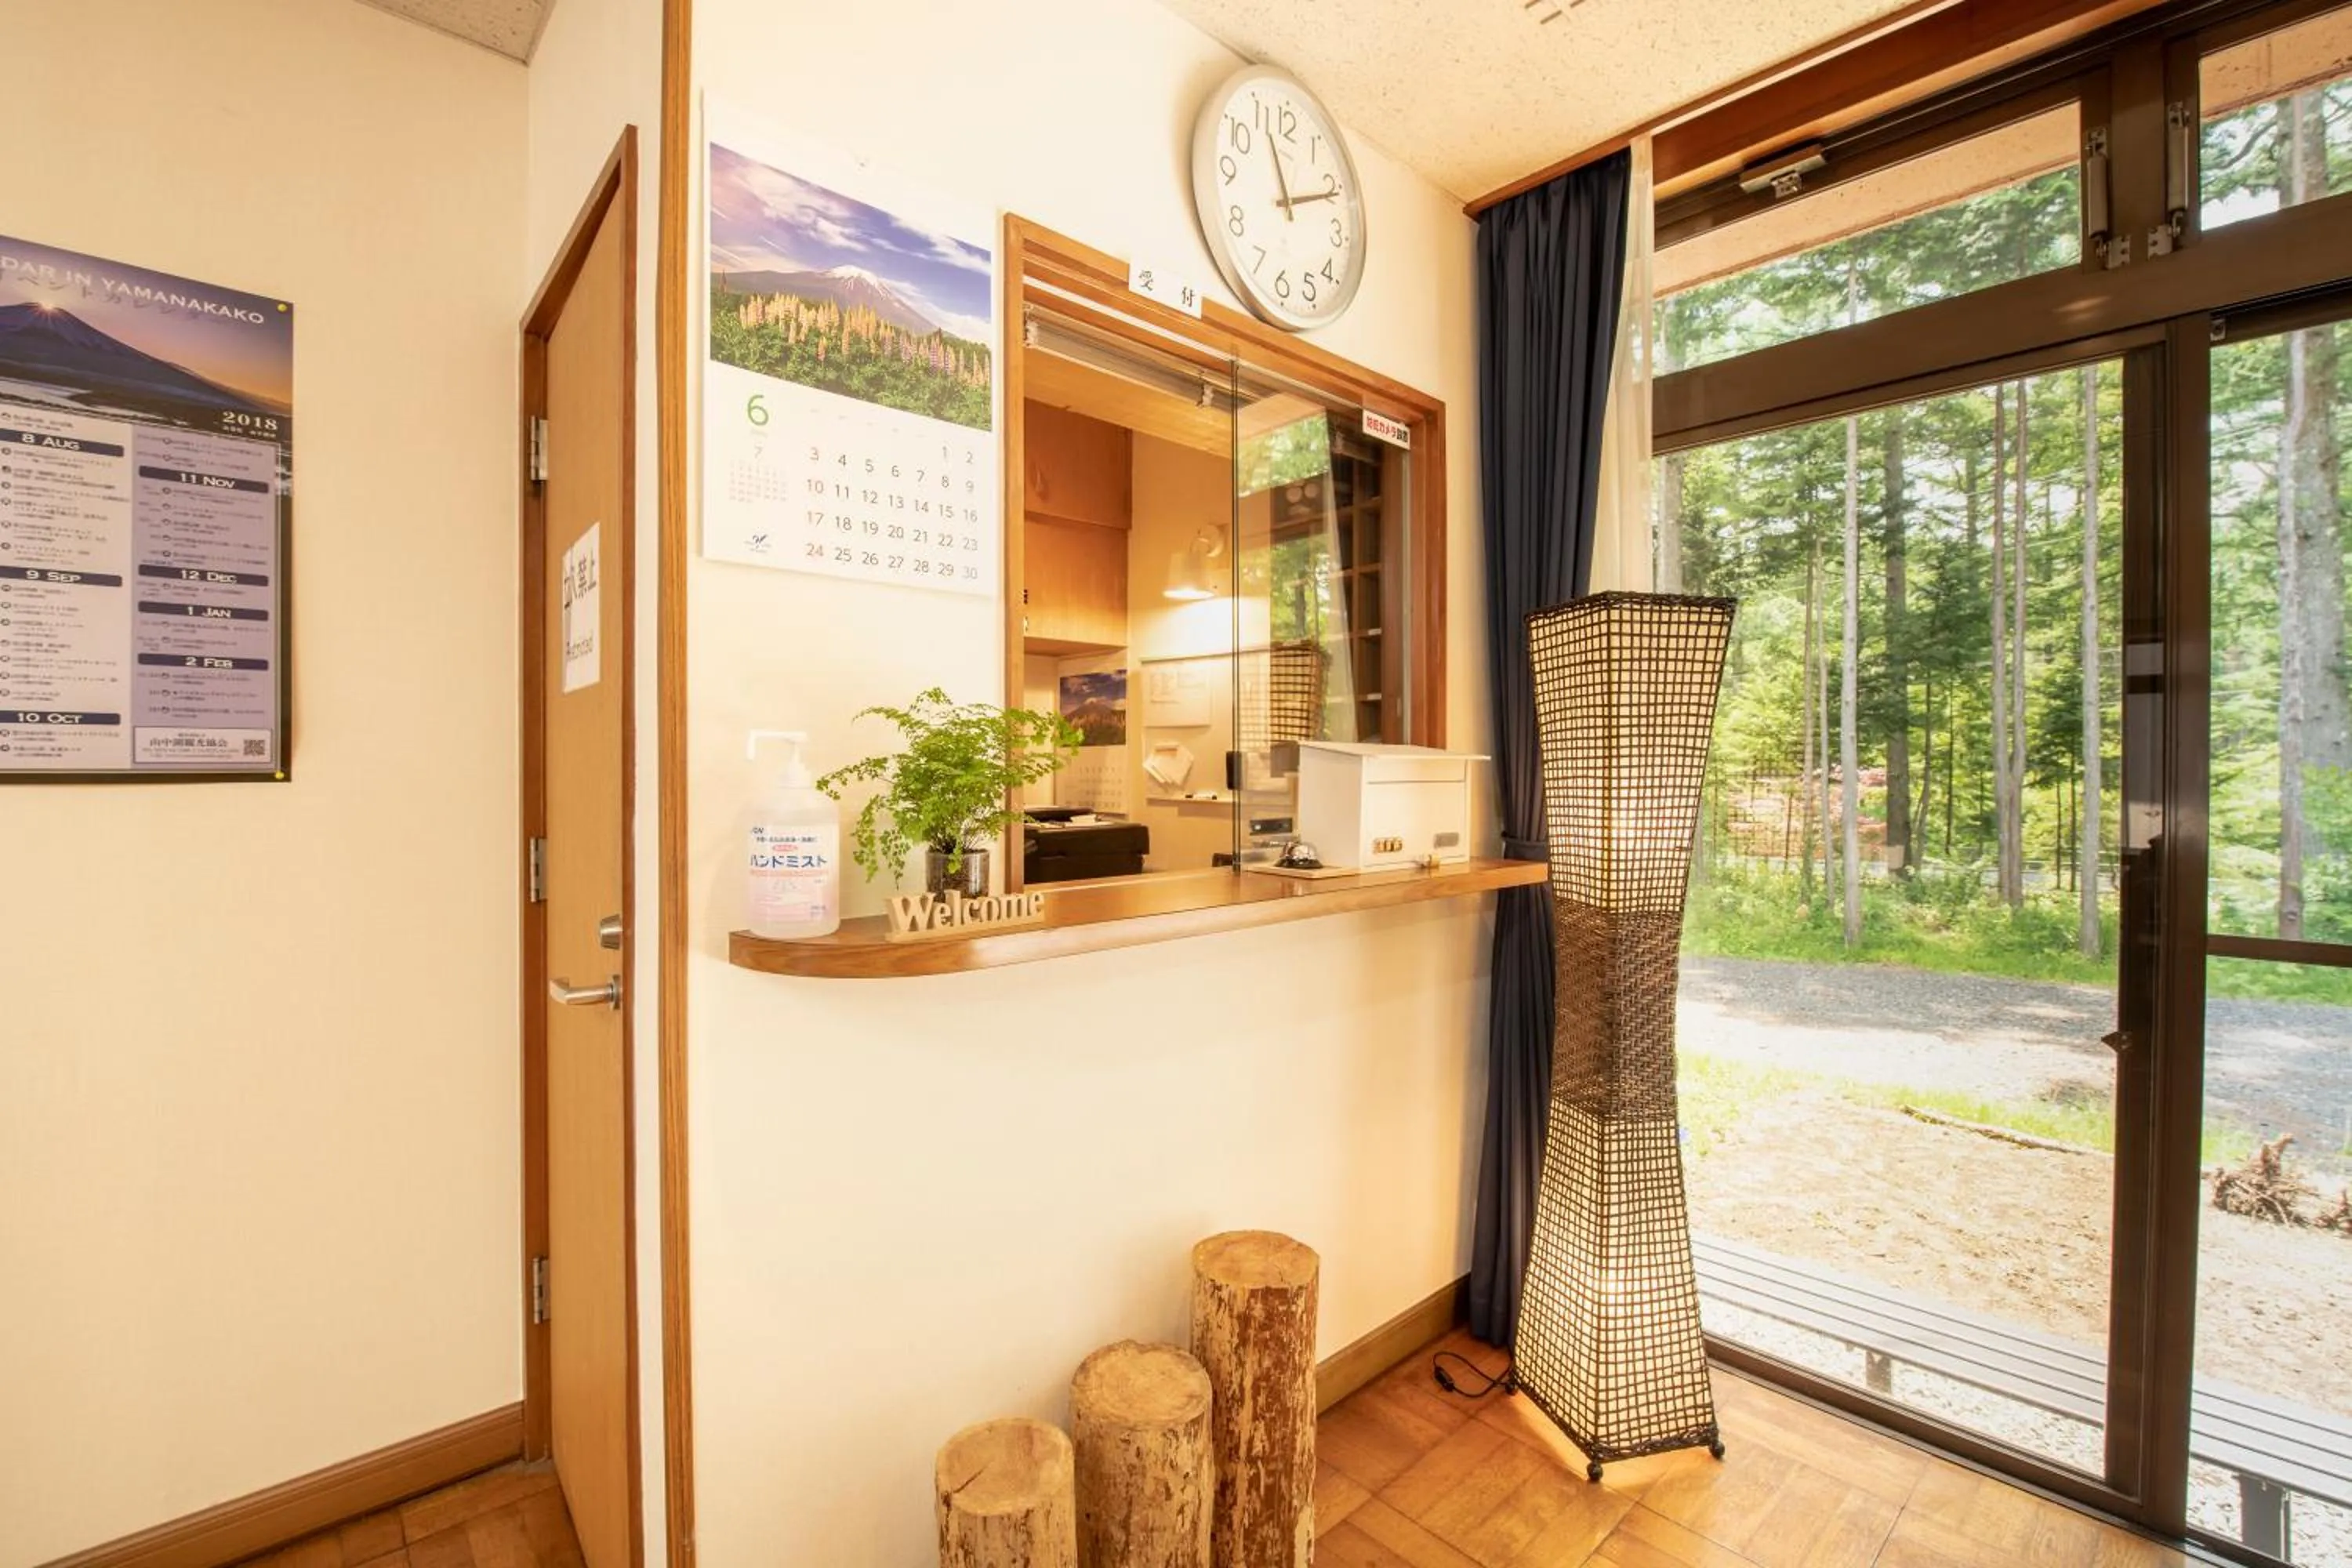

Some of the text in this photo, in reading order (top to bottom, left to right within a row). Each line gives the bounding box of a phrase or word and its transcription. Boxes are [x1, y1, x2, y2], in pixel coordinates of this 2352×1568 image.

[1254, 99, 1269, 136] 11
[1278, 105, 1297, 144] 12
[1230, 117, 1250, 154] 10
[1311, 136, 1316, 164] 1
[1220, 155, 1236, 186] 9
[1323, 173, 1336, 205] 2
[1229, 205, 1244, 237] 8
[1330, 218, 1341, 248] 3
[1253, 245, 1267, 274] 7
[1320, 259, 1333, 282] 4
[1, 256, 264, 324] DAR IN YAMANAKAKO
[1138, 270, 1196, 307] 受付
[1274, 270, 1290, 299] 6
[1302, 272, 1316, 302] 5
[223, 411, 279, 431] 2018
[747, 394, 769, 426] 6
[22, 434, 32, 444] 8
[942, 445, 974, 464] 1 2
[180, 473, 196, 484] 11
[810, 447, 974, 493] 3 4 5 6 7 8 9
[808, 479, 978, 522] 10 11 12 13 14 15 16
[808, 511, 978, 550] 17 18 19 20 21 22 23
[26, 570, 39, 580] 9
[180, 569, 199, 580] 12
[807, 543, 978, 579] 24 25 26 27 28 29 30
[187, 606, 194, 616] 1
[185, 656, 197, 666] 2
[17, 713, 39, 723] 10
[750, 855, 828, 869] ハンドミスト
[887, 889, 1046, 933] Welcome
